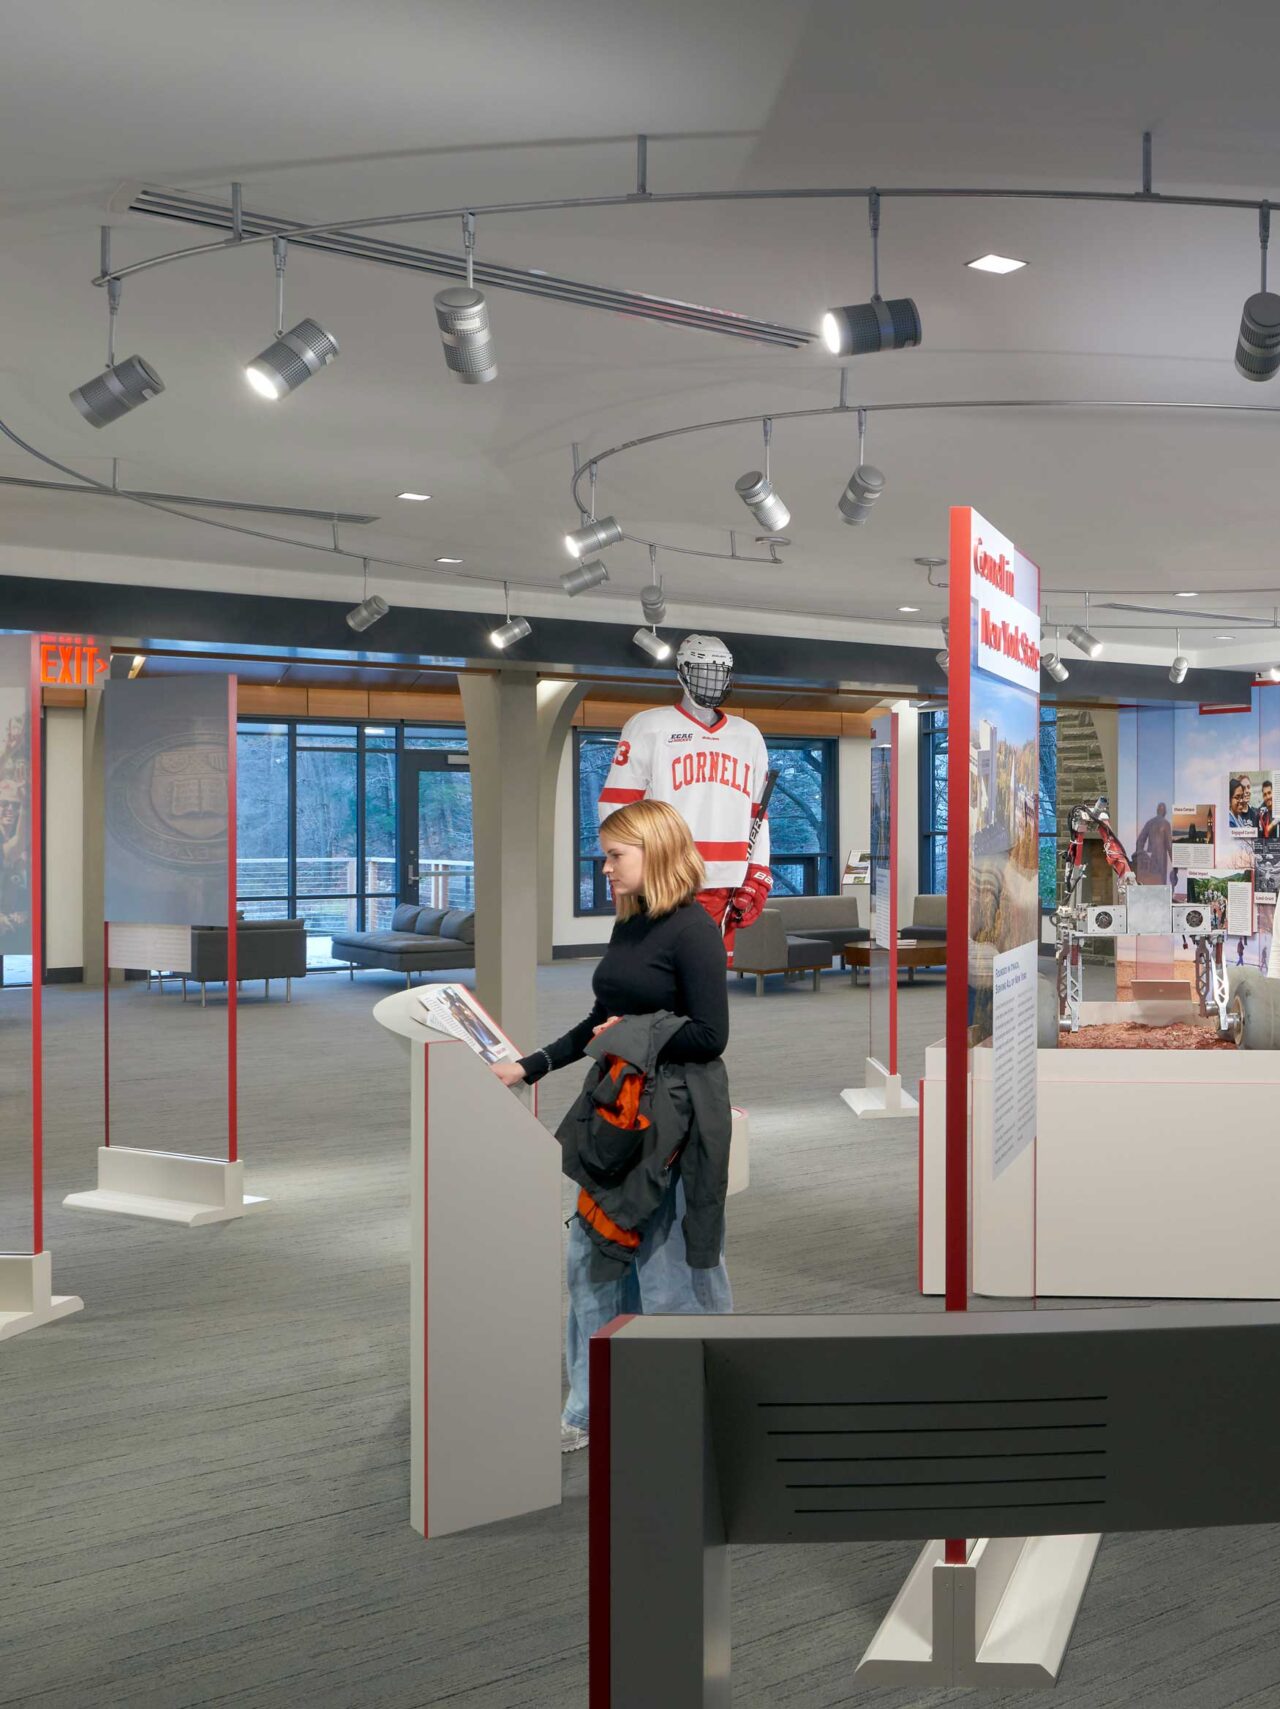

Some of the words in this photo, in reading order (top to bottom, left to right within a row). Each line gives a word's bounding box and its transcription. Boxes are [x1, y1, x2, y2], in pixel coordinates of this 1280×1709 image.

[41, 644, 99, 685] EXIT
[612, 741, 630, 766] 3
[671, 751, 751, 798] CORNELL
